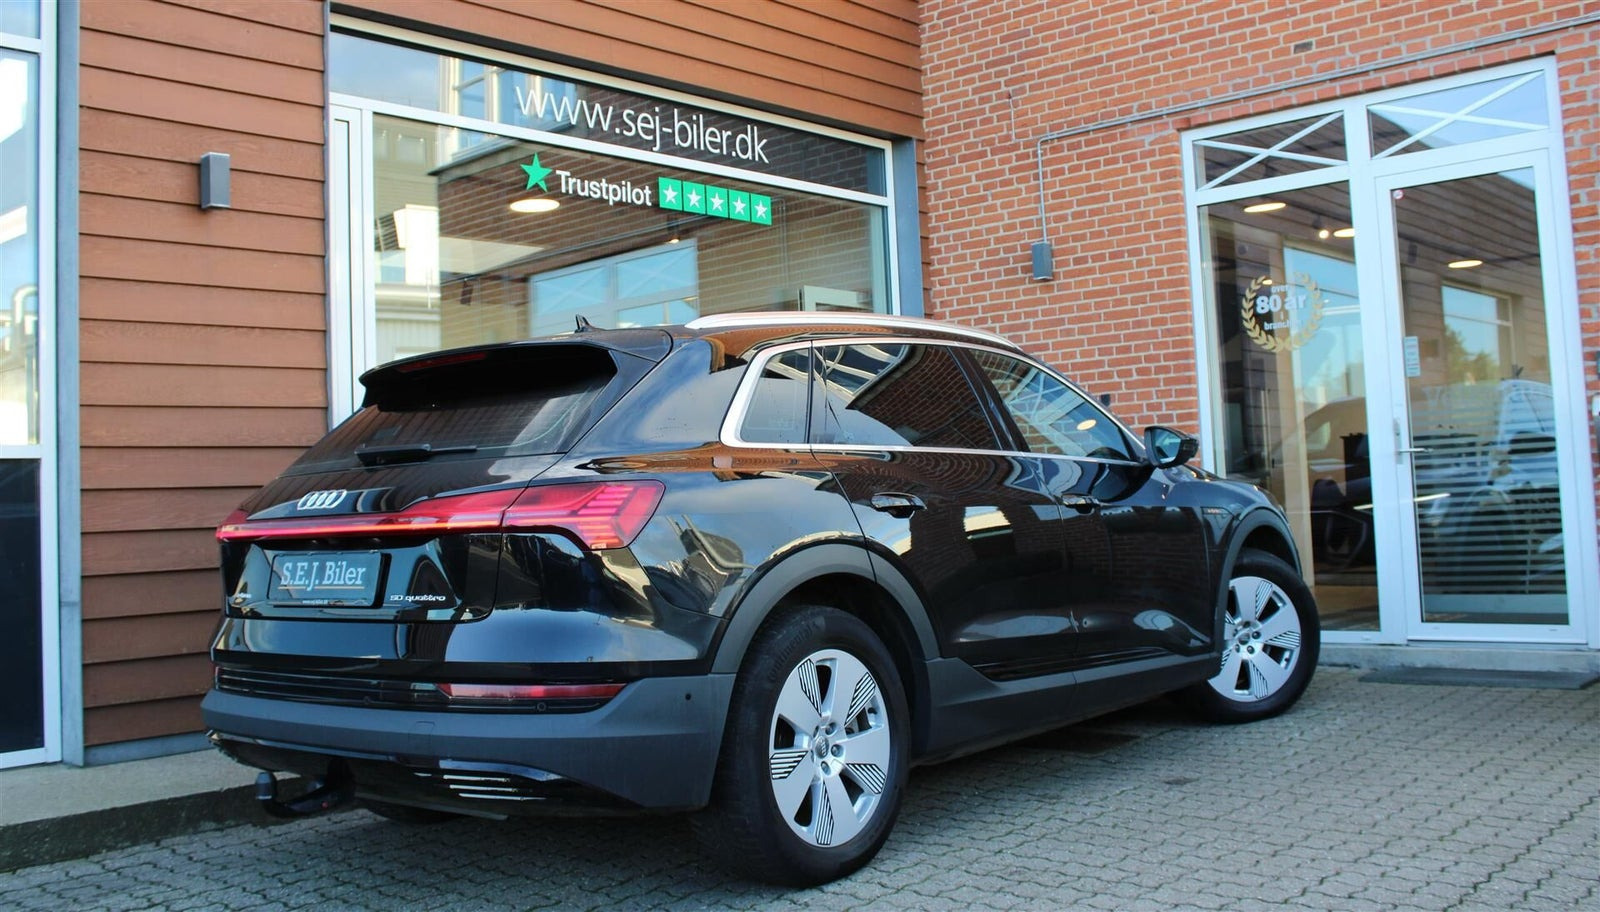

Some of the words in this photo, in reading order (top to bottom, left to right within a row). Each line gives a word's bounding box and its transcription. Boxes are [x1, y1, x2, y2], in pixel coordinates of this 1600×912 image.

[515, 86, 769, 164] www.sej-biler.dk
[556, 169, 653, 206] Trustpilot
[1256, 294, 1282, 314] 80
[280, 561, 320, 591] S.E.J.
[322, 560, 367, 585] Biler
[405, 594, 446, 602] quattro
